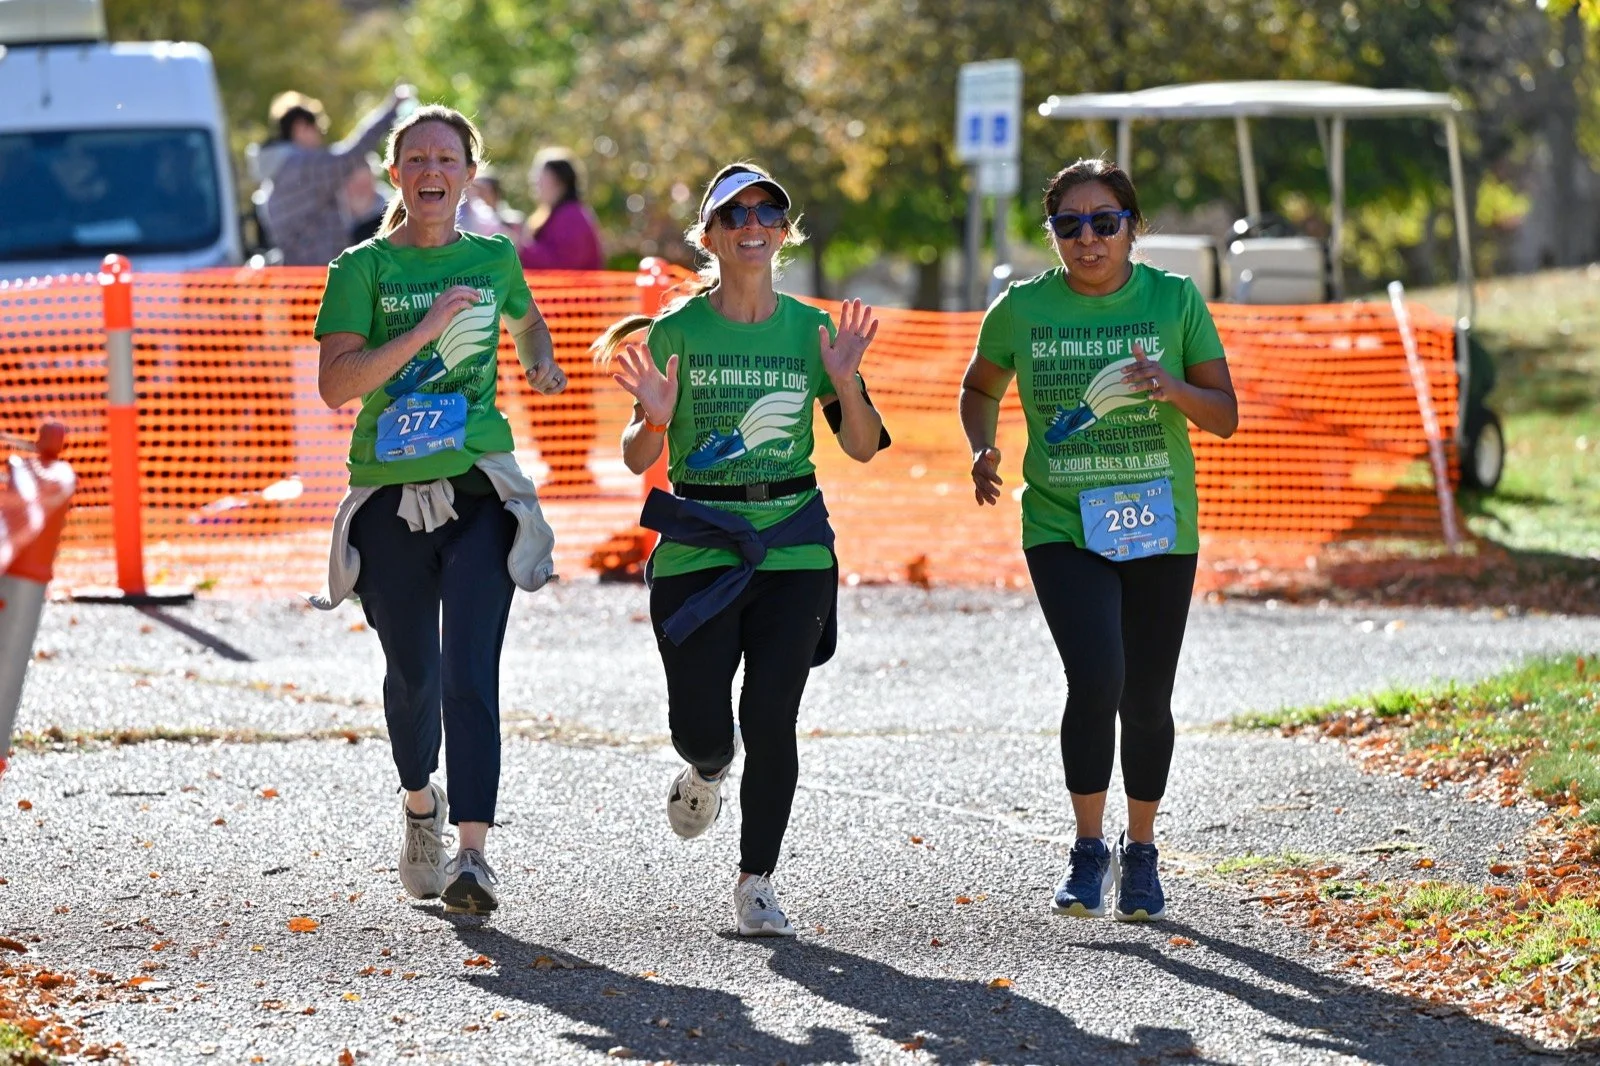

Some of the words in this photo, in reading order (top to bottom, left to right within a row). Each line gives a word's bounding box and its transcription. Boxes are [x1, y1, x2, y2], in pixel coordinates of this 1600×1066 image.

[379, 283, 403, 295] RUN
[407, 280, 439, 293] WITH
[381, 296, 410, 313] 52.4
[385, 314, 411, 327] WALK
[1031, 327, 1053, 340] RUN
[1059, 326, 1091, 339] WITH
[1097, 322, 1159, 338] PURPOSE.
[1032, 341, 1057, 358] 52.4
[1061, 340, 1102, 357] MILES
[1107, 338, 1124, 355] OF
[689, 354, 712, 368] RUN
[718, 354, 750, 368] WITH
[755, 356, 808, 372] PURPOSE.
[1033, 360, 1055, 372] WALK
[1060, 359, 1086, 371] WITH
[690, 370, 718, 386] 52.4
[721, 369, 761, 386] MILES
[764, 371, 779, 387] OF
[783, 372, 808, 391] LOVE
[1033, 373, 1092, 387] ENDURANCE
[692, 388, 716, 400] WALK
[720, 388, 744, 399] WITH
[1033, 388, 1080, 401] PATIENCE
[693, 402, 749, 415] ENDURANCE
[397, 410, 444, 435] 277
[695, 415, 738, 429] PATIENCE
[1084, 423, 1166, 442] PERSEVERANCE.
[1098, 443, 1130, 455] FINISH
[1133, 440, 1167, 453] STRONG.
[1064, 458, 1092, 471] YOUR
[1095, 456, 1122, 469] EYES
[1125, 454, 1141, 468] ON
[1143, 452, 1169, 467] JESUS
[1086, 473, 1116, 481] HIV/AIDS
[1118, 472, 1153, 480] ORPHANS
[1147, 488, 1162, 497] 13.1
[1105, 504, 1156, 533] 286
